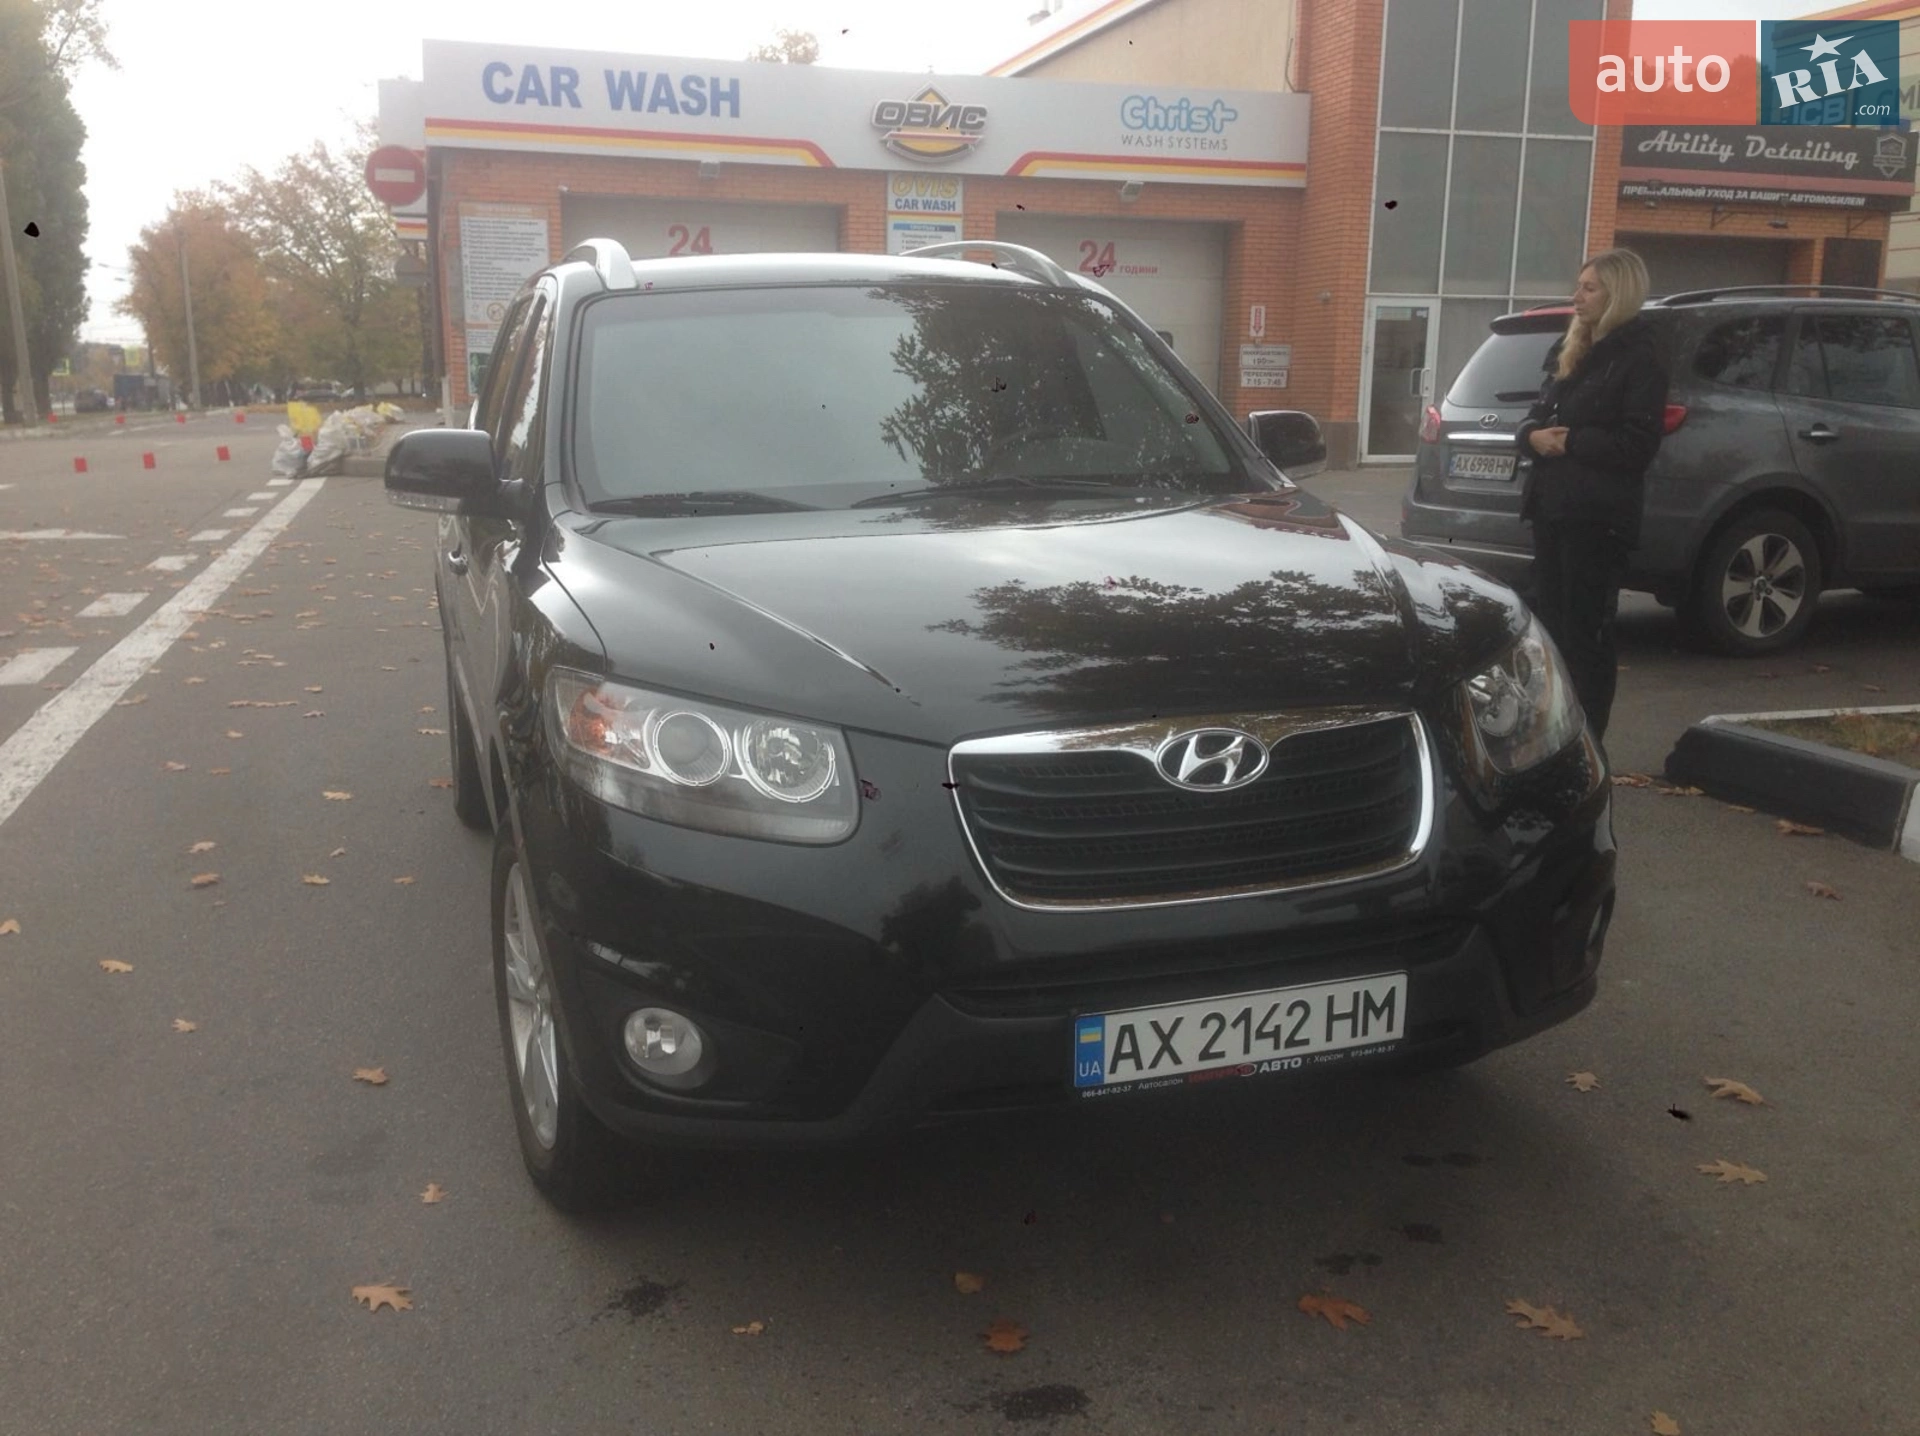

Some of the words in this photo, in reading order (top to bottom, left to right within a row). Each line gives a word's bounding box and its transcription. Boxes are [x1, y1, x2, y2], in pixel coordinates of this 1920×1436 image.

[481, 61, 582, 109] CAR
[604, 69, 741, 119] WASH
[874, 100, 988, 130] ОВИС
[1121, 95, 1238, 133] Christ
[1121, 134, 1163, 147] WASH
[1167, 136, 1229, 151] SYSTEMS
[1638, 130, 1734, 163] Ability
[1745, 135, 1859, 170] Detailing
[895, 199, 919, 210] CAR
[922, 199, 956, 211] WASH
[1707, 189, 1734, 200] УХОД
[1735, 190, 1748, 199] ЗА
[1789, 193, 1866, 206] АВТОМОБИЛЕМ
[668, 223, 713, 256] 24
[1079, 240, 1117, 273] 24
[1120, 264, 1158, 274] години
[1108, 1016, 1184, 1075] AX
[1198, 1000, 1311, 1062] 2142
[1325, 985, 1397, 1043] HM
[1079, 1061, 1101, 1077] UA
[1259, 1057, 1302, 1074] АВТО
[1138, 1078, 1184, 1091] Автосалон
